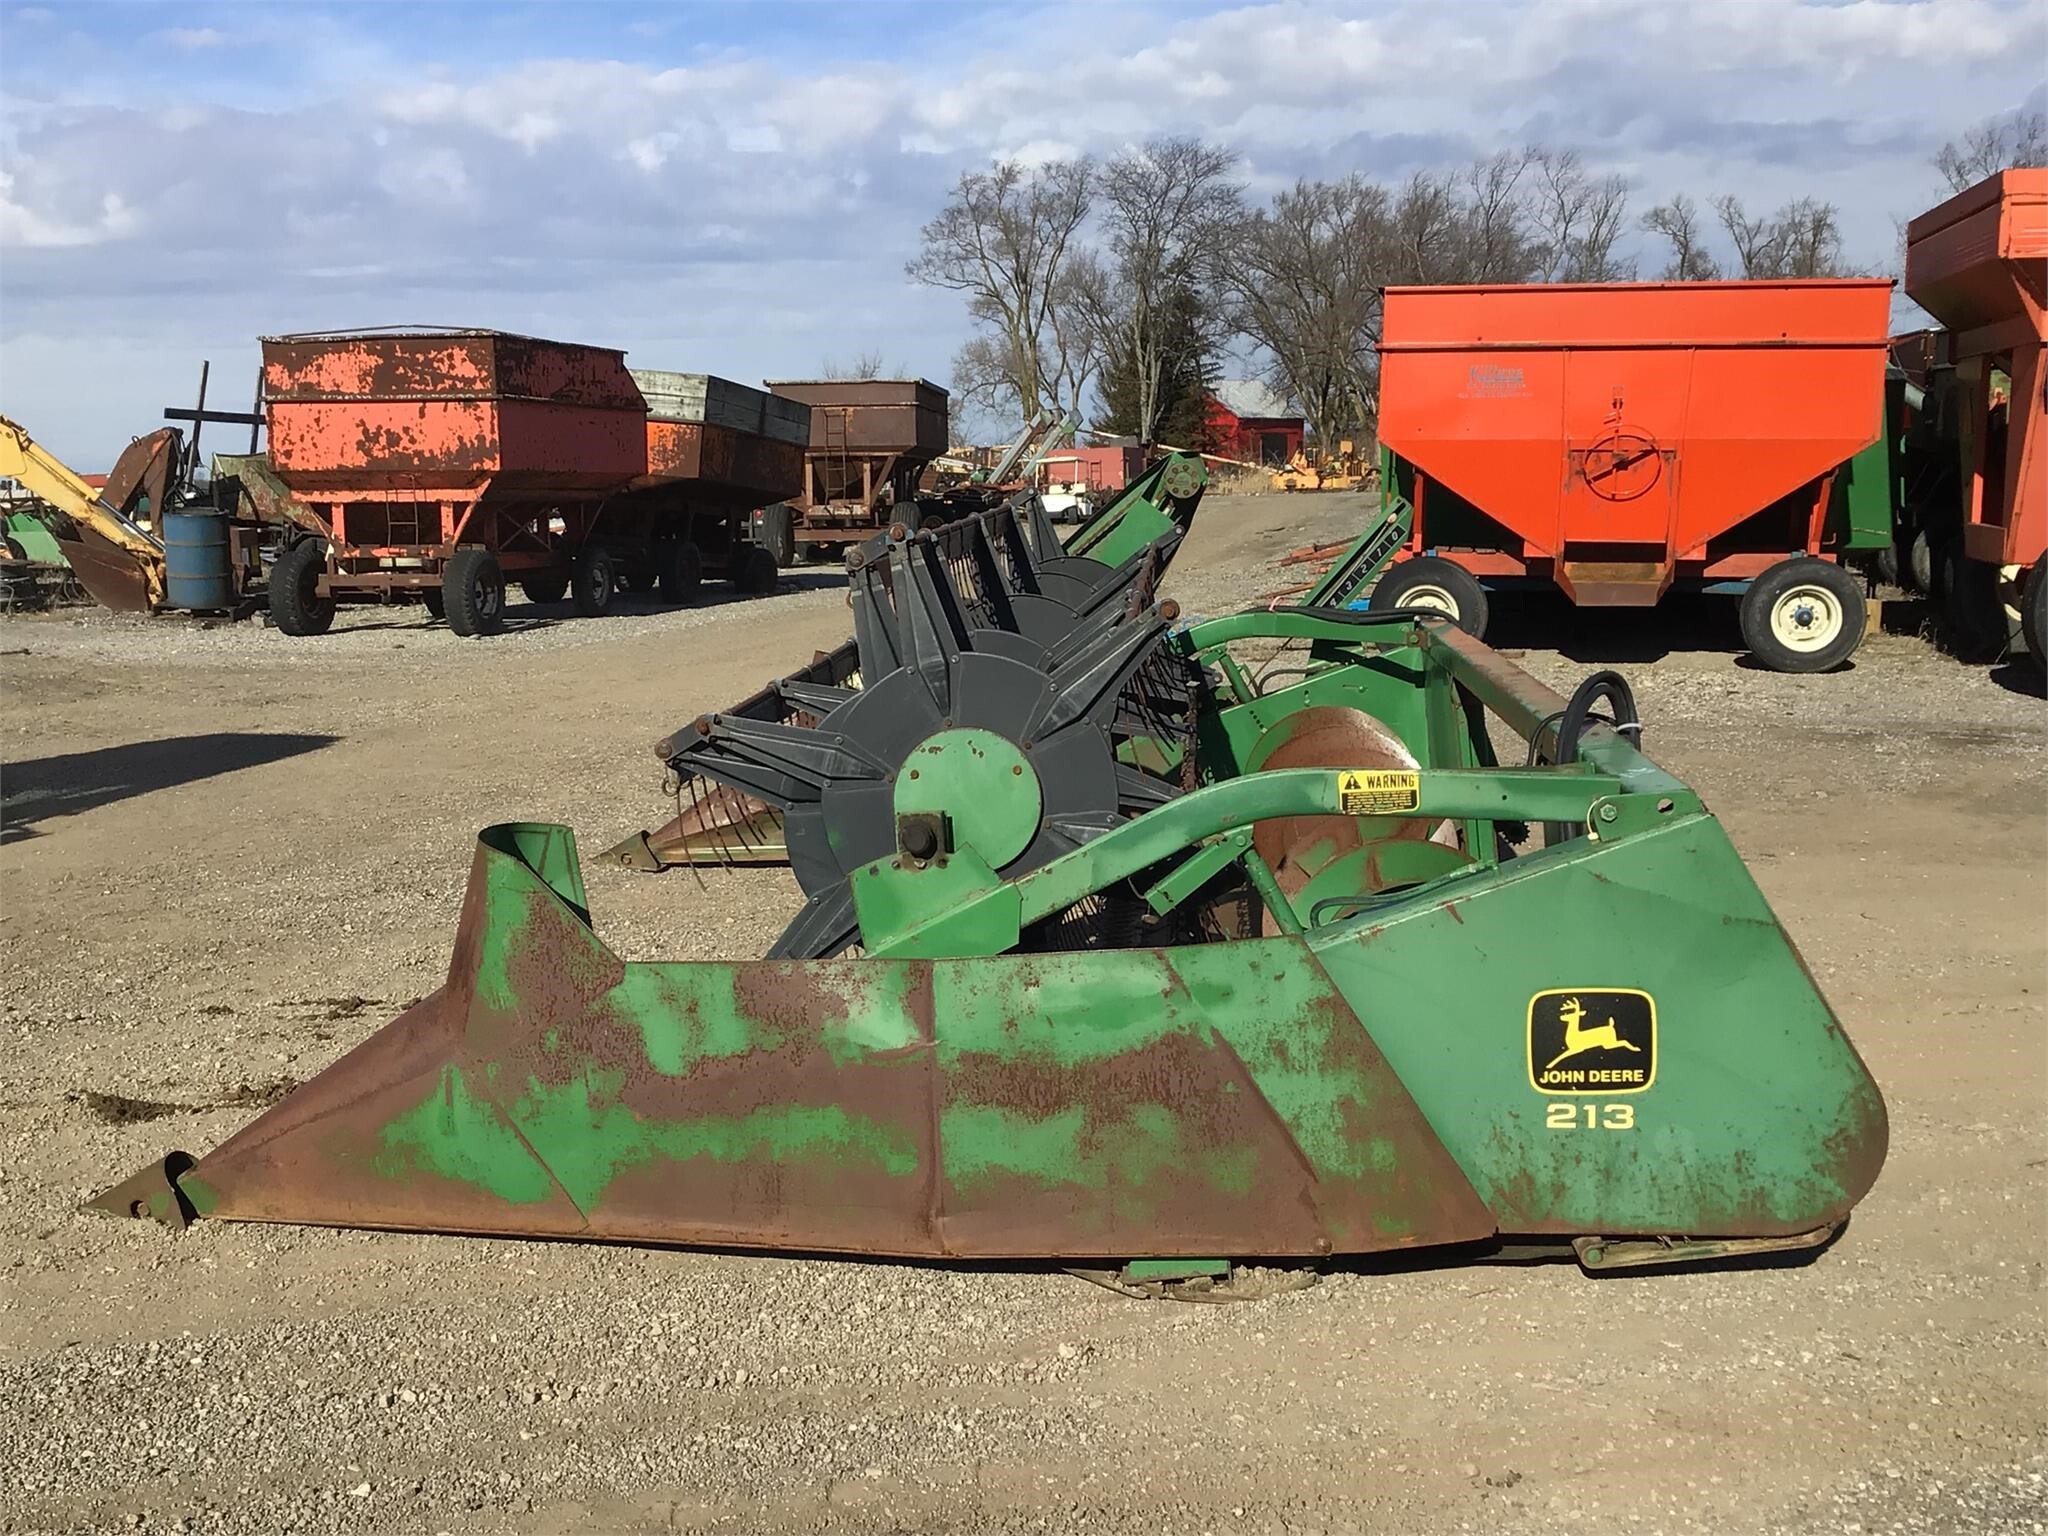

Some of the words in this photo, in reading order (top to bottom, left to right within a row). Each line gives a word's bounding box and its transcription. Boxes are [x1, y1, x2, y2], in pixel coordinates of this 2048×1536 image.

[1345, 581, 1353, 591] 3
[1360, 564, 1368, 574] 2
[1376, 547, 1383, 558] 1
[1391, 531, 1399, 541] 0
[1366, 774, 1415, 789] WARNING
[1539, 1070, 1585, 1084] JOHN
[1589, 1069, 1644, 1083] DEERE
[1546, 1103, 1635, 1130] 213
